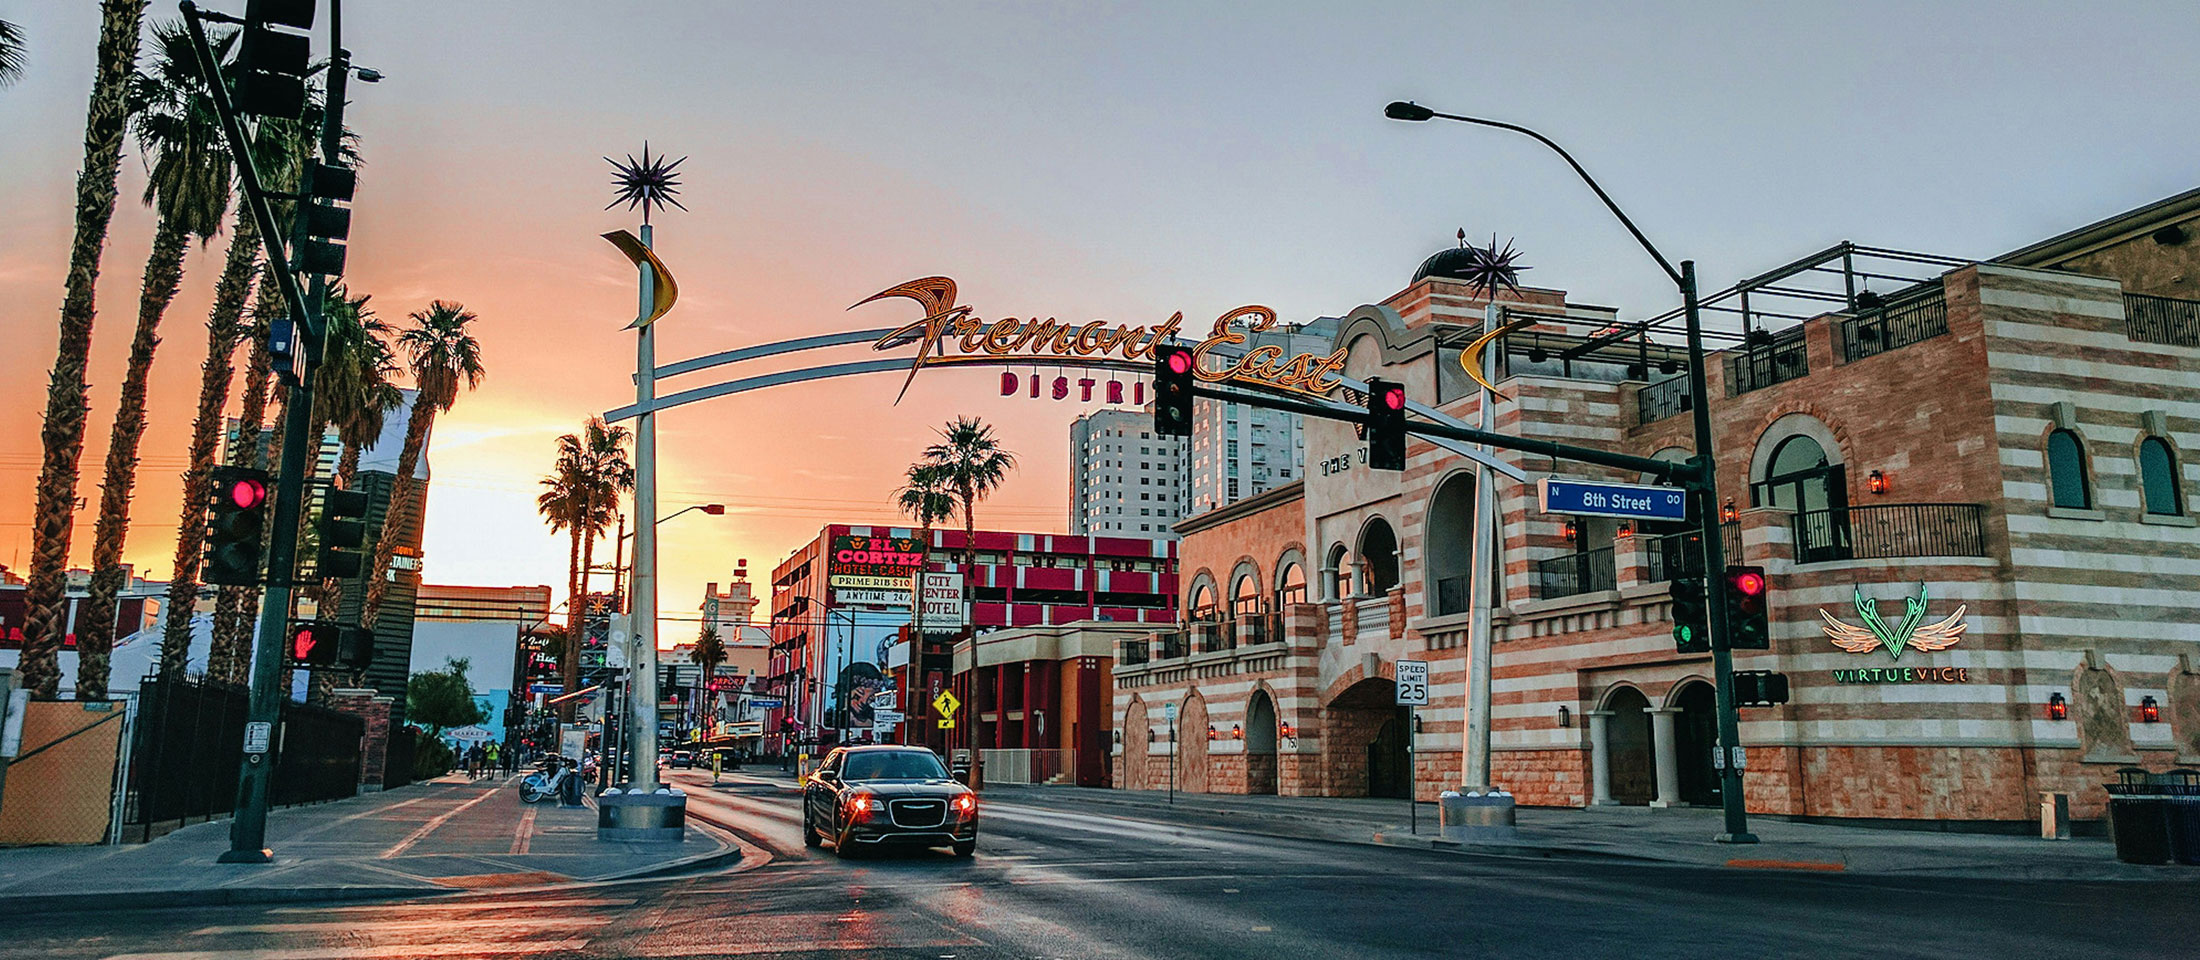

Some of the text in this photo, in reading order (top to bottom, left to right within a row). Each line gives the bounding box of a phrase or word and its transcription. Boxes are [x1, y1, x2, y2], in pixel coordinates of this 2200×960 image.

[846, 276, 1348, 406] Fremont East
[1000, 371, 1155, 405] DISTRI
[1320, 453, 1350, 476] THE
[1551, 486, 1560, 497] N
[1583, 491, 1606, 508] 8th
[1611, 493, 1652, 511] Street
[868, 538, 895, 552] EL
[836, 549, 923, 566] CORTEZ
[834, 563, 873, 576] HOTEL
[838, 576, 871, 587] PRIME
[873, 579, 891, 588] RIB
[927, 575, 951, 587] CITY
[846, 591, 886, 601] ANYTIME
[924, 588, 960, 600] ENTER
[1399, 665, 1426, 674] SPEED
[1401, 674, 1423, 682] LIMIT
[1400, 683, 1426, 700] 25
